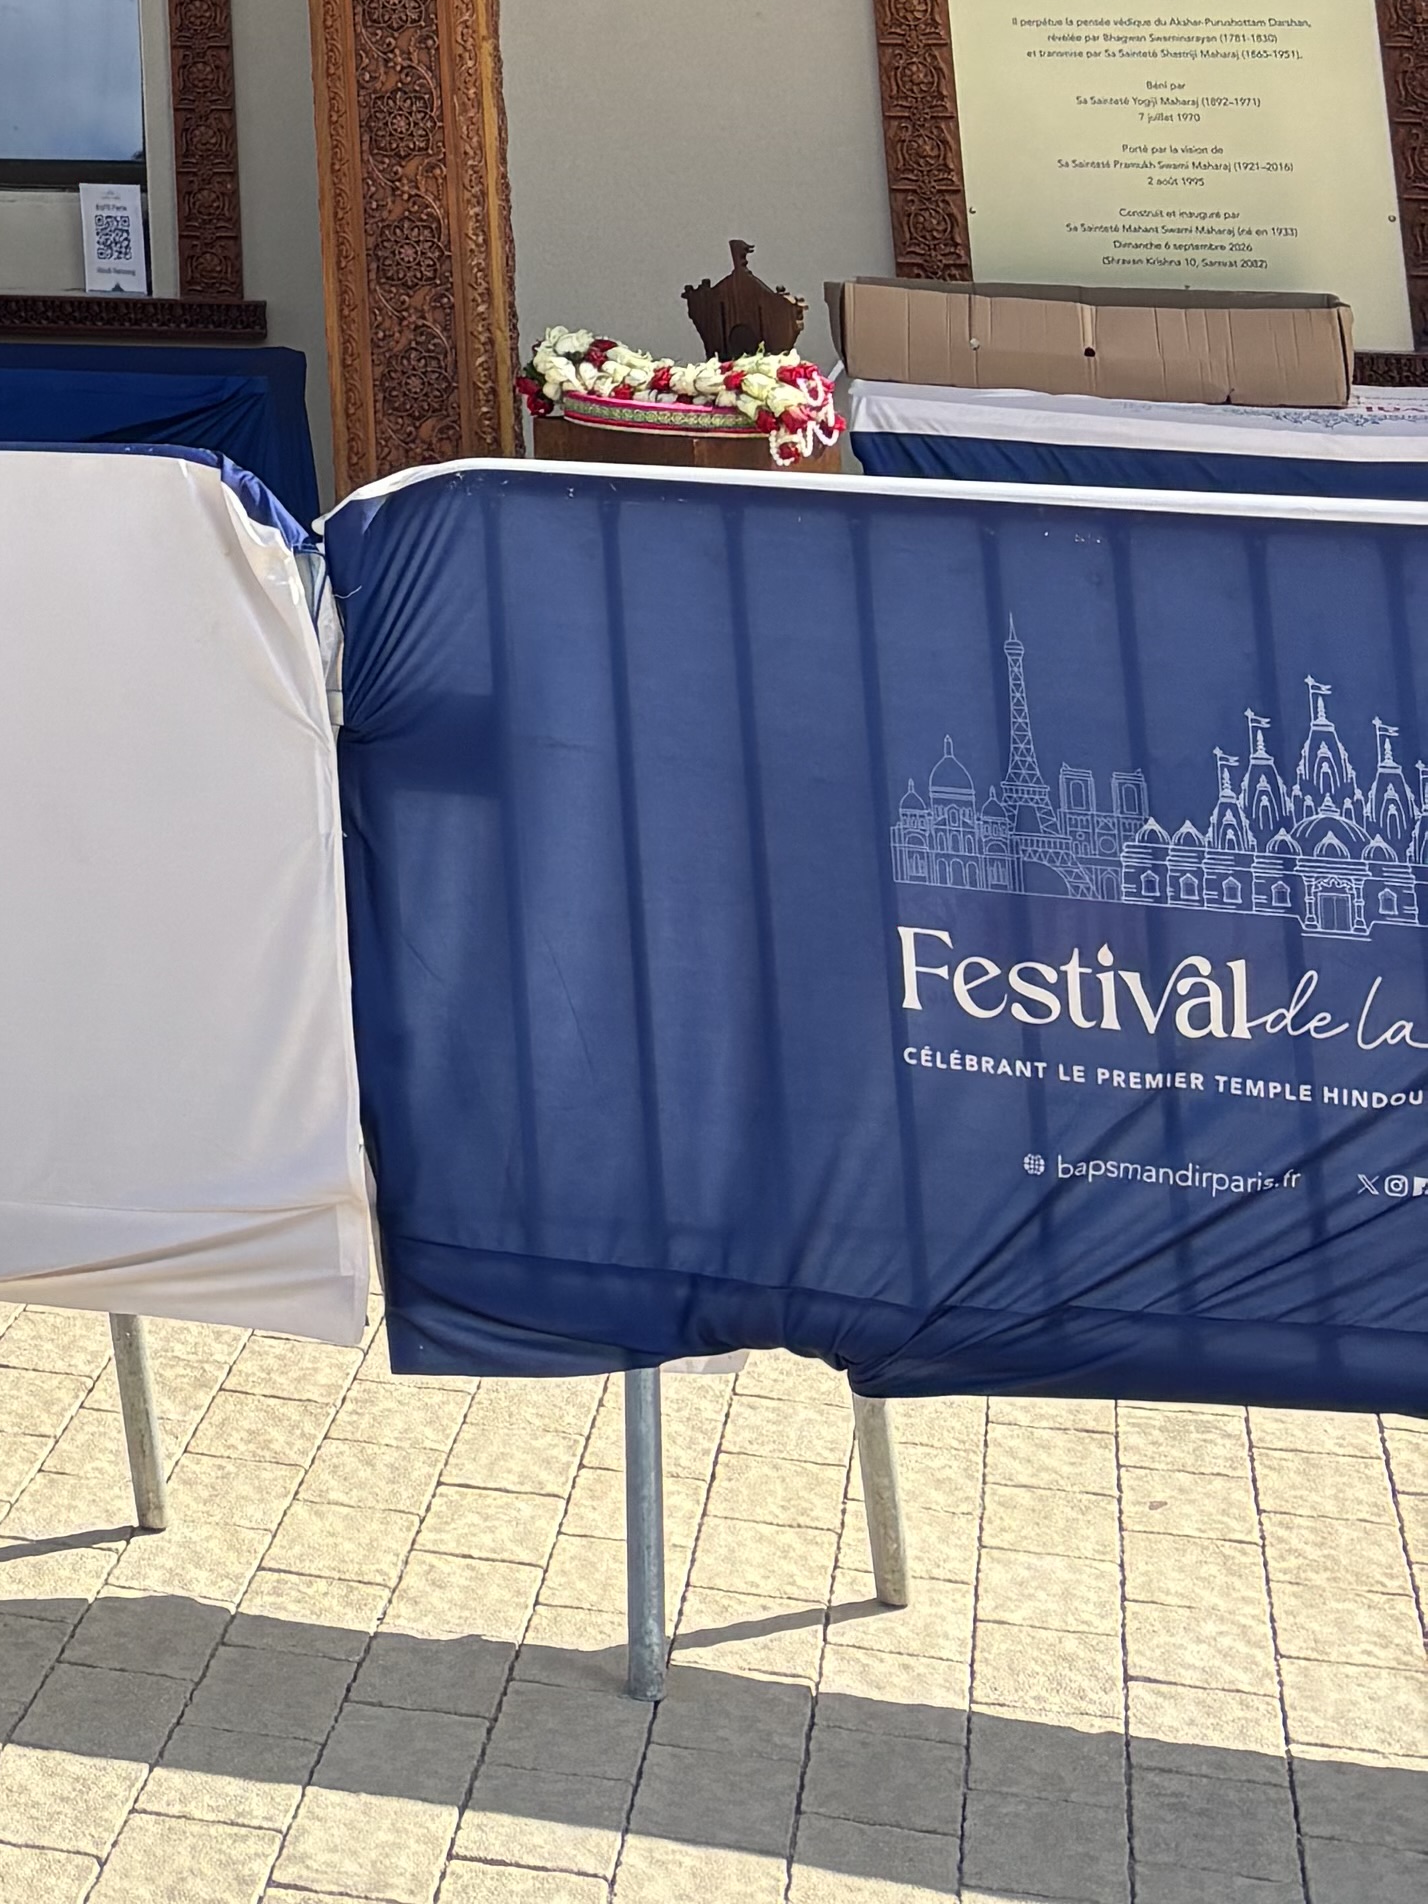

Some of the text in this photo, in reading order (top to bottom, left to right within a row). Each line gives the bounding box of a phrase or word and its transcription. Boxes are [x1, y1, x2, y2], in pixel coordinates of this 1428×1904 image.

[896, 925, 1428, 1051] Festival de la
[903, 1045, 1424, 1110] CÉLÉBRANT LE PREMIER TEMPLE HINDOU
[1057, 1154, 1301, 1197] bapsmandirparis.fr
